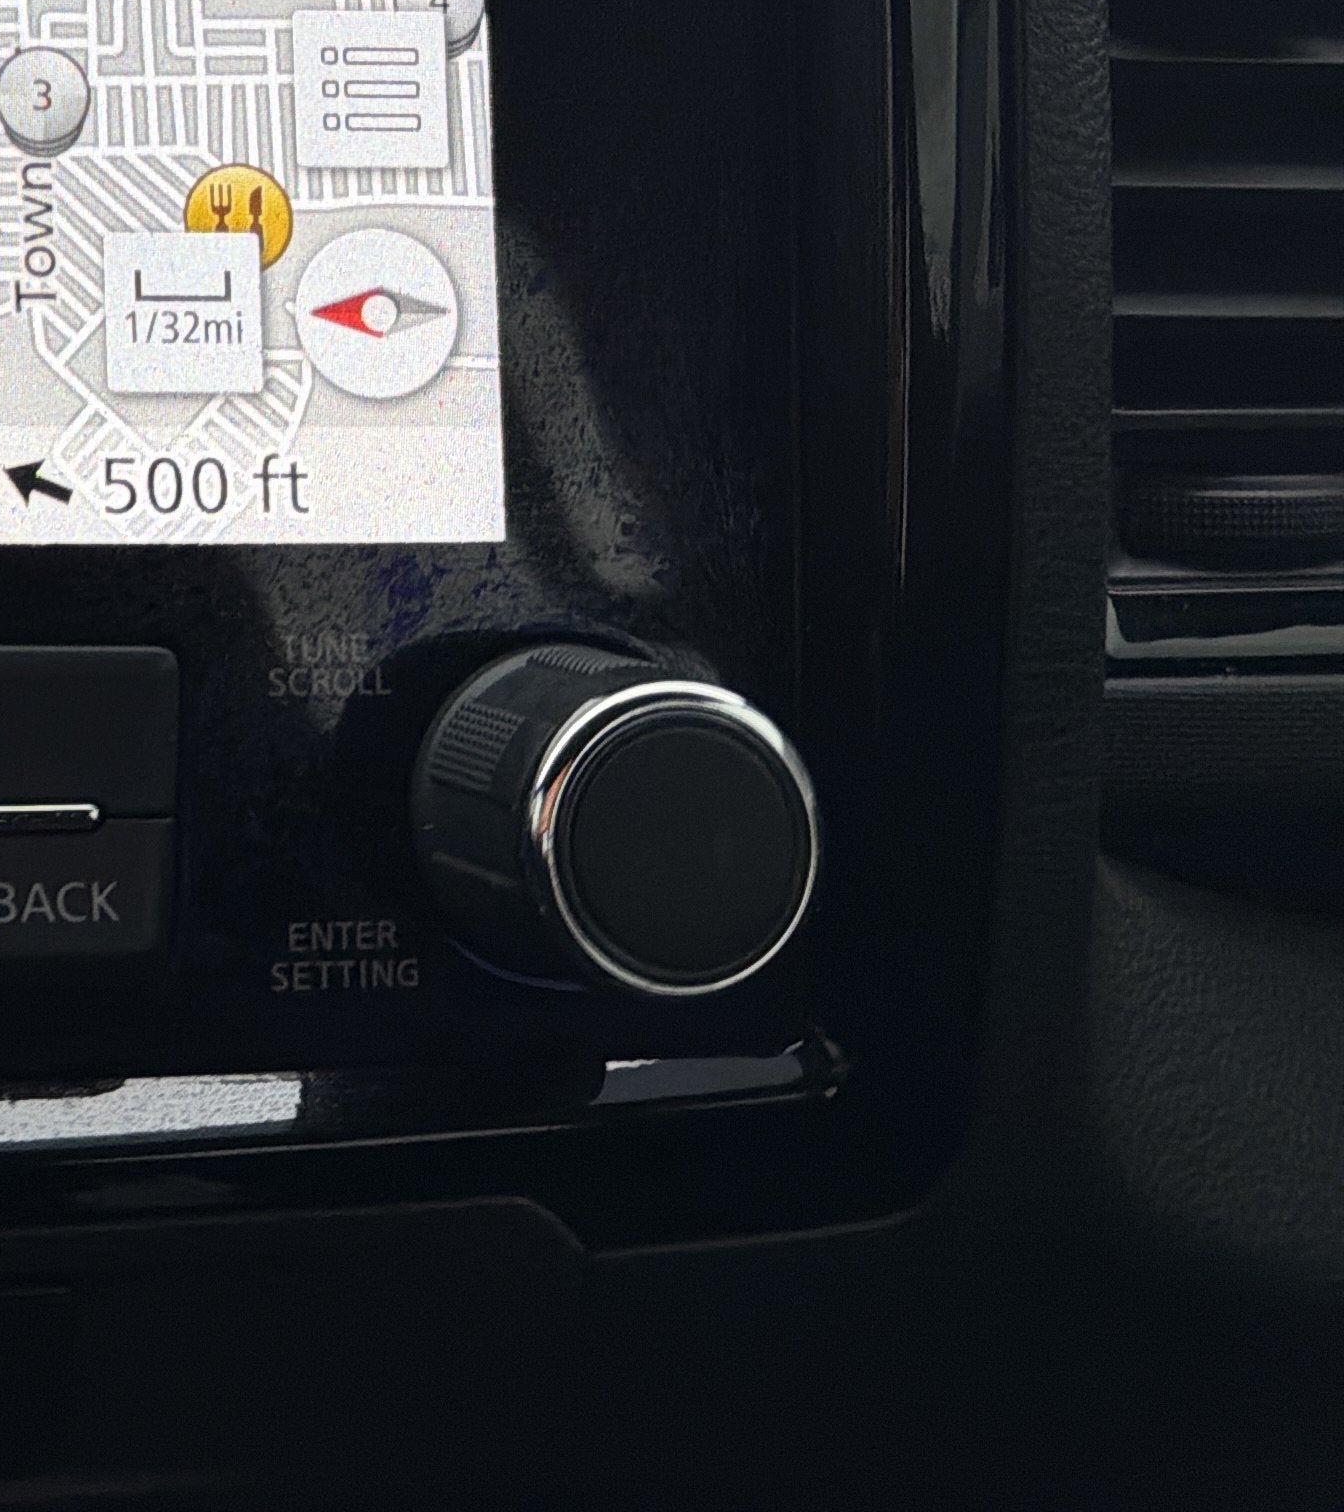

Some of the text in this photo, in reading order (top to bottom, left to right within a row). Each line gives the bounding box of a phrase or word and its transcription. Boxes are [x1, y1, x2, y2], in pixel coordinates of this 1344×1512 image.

[33, 82, 53, 112] 3
[15, 162, 57, 313] Town
[124, 310, 244, 346] 1/32mi
[103, 454, 310, 515] 500 ft
[281, 633, 368, 662] TUNE
[267, 666, 392, 697] SCROLL
[288, 921, 399, 953] ENTER
[270, 958, 421, 992] SETTING
